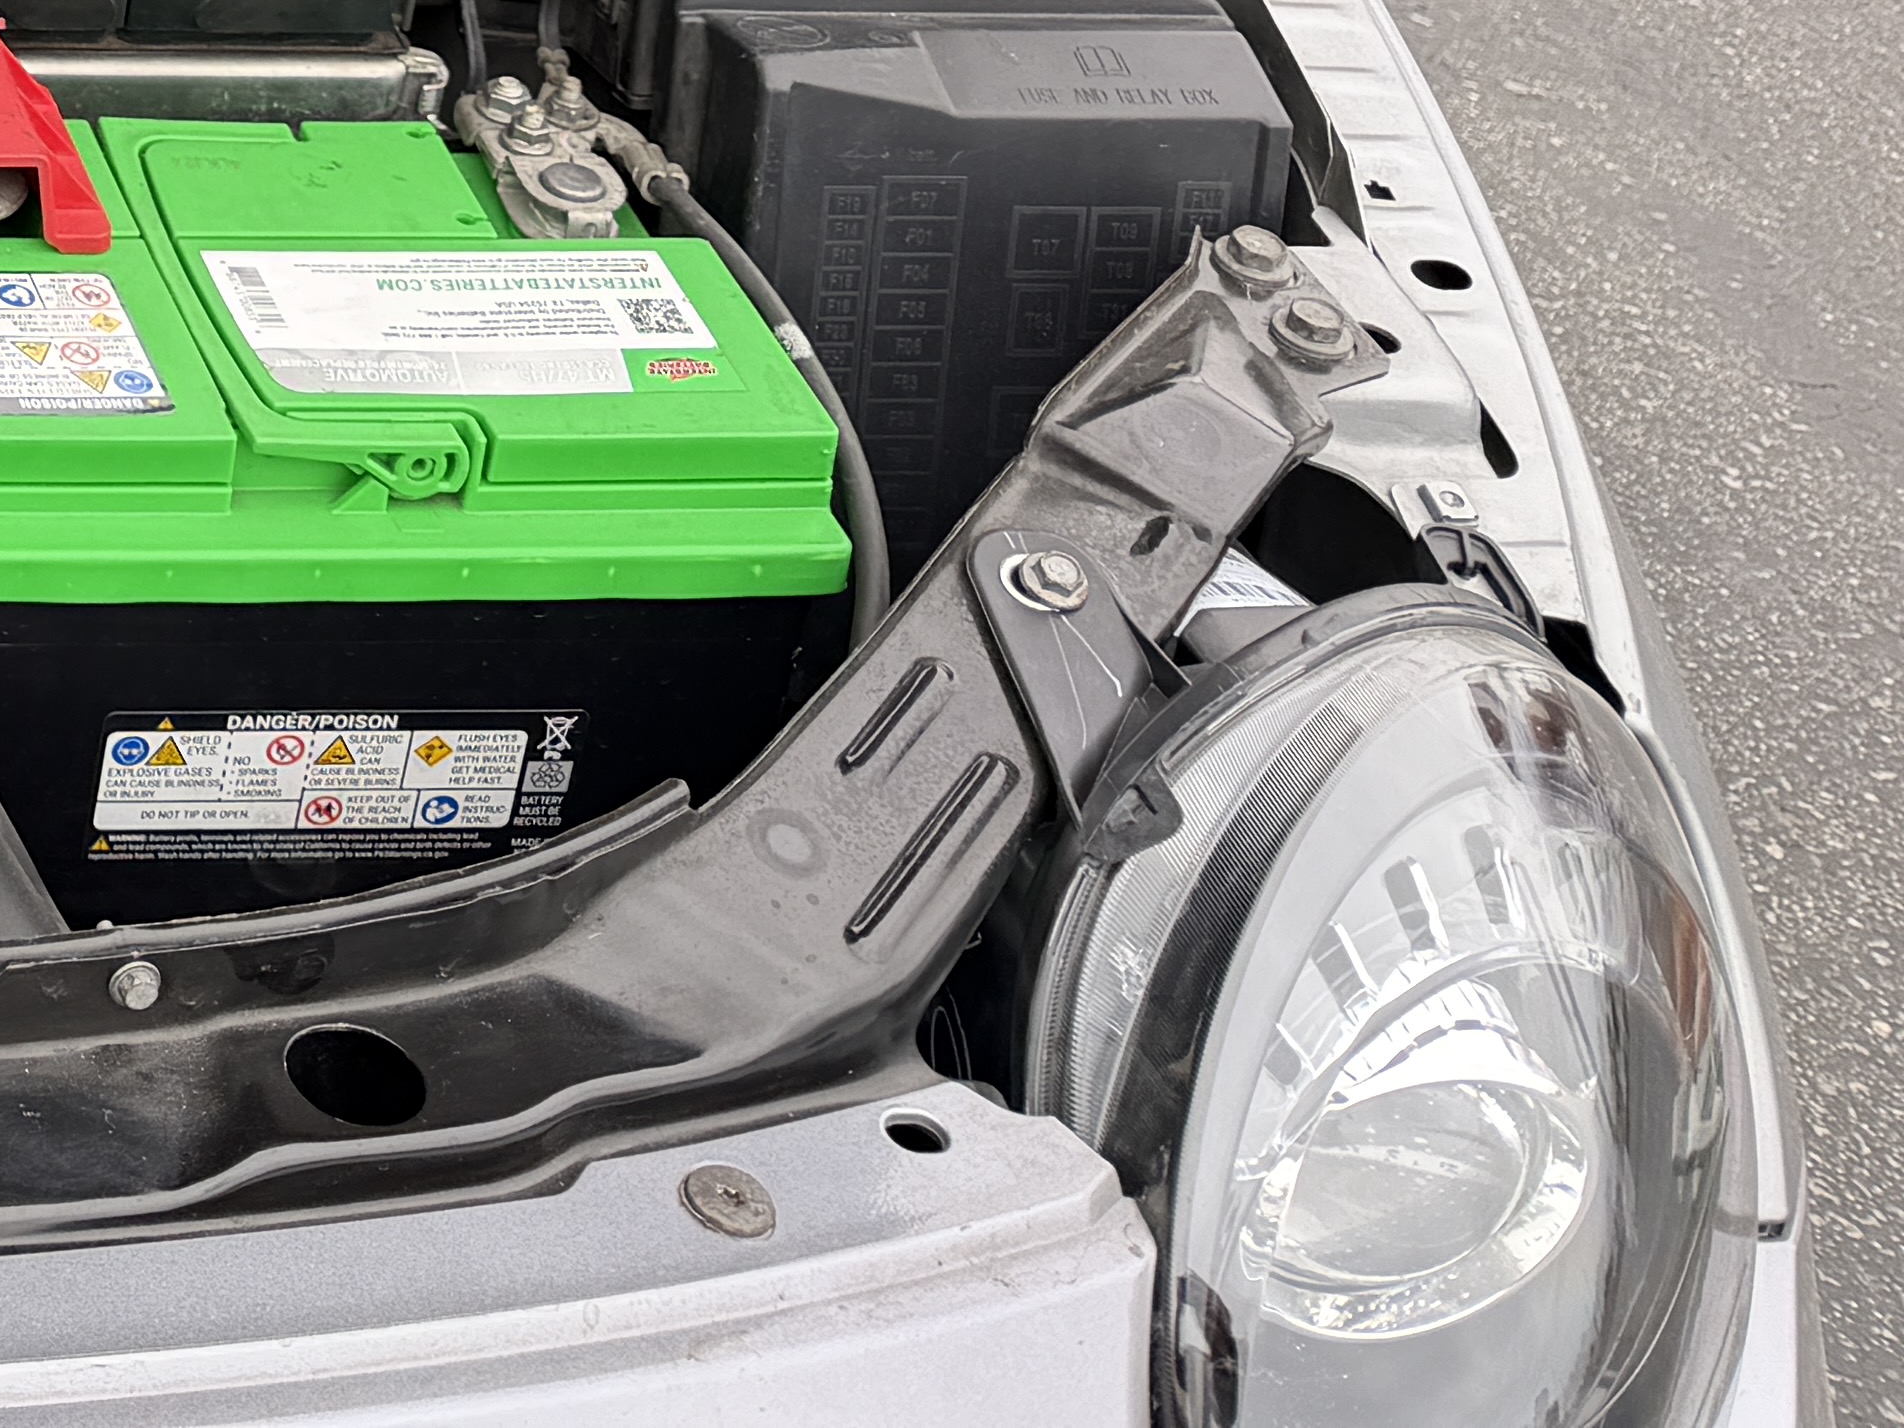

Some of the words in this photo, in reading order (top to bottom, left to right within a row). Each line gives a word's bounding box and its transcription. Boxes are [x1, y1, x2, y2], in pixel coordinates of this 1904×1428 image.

[1073, 87, 1109, 105] AND
[375, 277, 662, 291] INTERSTATEBATTERIES.COM
[321, 368, 448, 383] AUTOMOTIVE
[18, 397, 144, 411] DANGER/POISON
[226, 714, 399, 730] DANGER/POISON
[179, 735, 222, 745] SHIELD
[348, 734, 404, 745] SULFURIC
[457, 734, 490, 742] FLUSH
[492, 734, 518, 742] EYES
[186, 746, 219, 756] EYES.
[355, 745, 385, 755] ACID
[455, 744, 522, 754] IMMEDIATELY
[232, 756, 251, 766] NO
[359, 757, 382, 766] CAN
[453, 755, 480, 764] WITH
[106, 767, 171, 777] EXPLOSIVE
[174, 767, 213, 777] GASES
[237, 767, 278, 777] SPARKS
[310, 767, 342, 776] CAUSE
[451, 765, 470, 775] GET
[472, 765, 518, 775] MEDICAL
[105, 779, 128, 788] CAN
[129, 779, 162, 788] CAUSE
[235, 778, 278, 787] FLAMES
[308, 777, 323, 787] OR
[448, 776, 476, 785] HELP
[233, 789, 282, 798] SMOKING
[346, 795, 373, 804] KEEP
[375, 795, 396, 804] OUT
[398, 795, 411, 804] OF
[463, 794, 491, 804] READ
[520, 795, 564, 805] BATTERY
[345, 805, 365, 814] THE
[367, 805, 402, 814] REACH
[461, 805, 507, 814] INSTRUC-
[518, 806, 546, 816] MUST
[547, 806, 561, 816] BE
[140, 810, 155, 820] DO
[157, 810, 180, 820] NOT
[183, 810, 201, 820] TIP
[202, 810, 218, 820] OR
[219, 810, 250, 820] OPEN.
[342, 816, 356, 825] OF
[512, 816, 562, 827] RECYCLED
